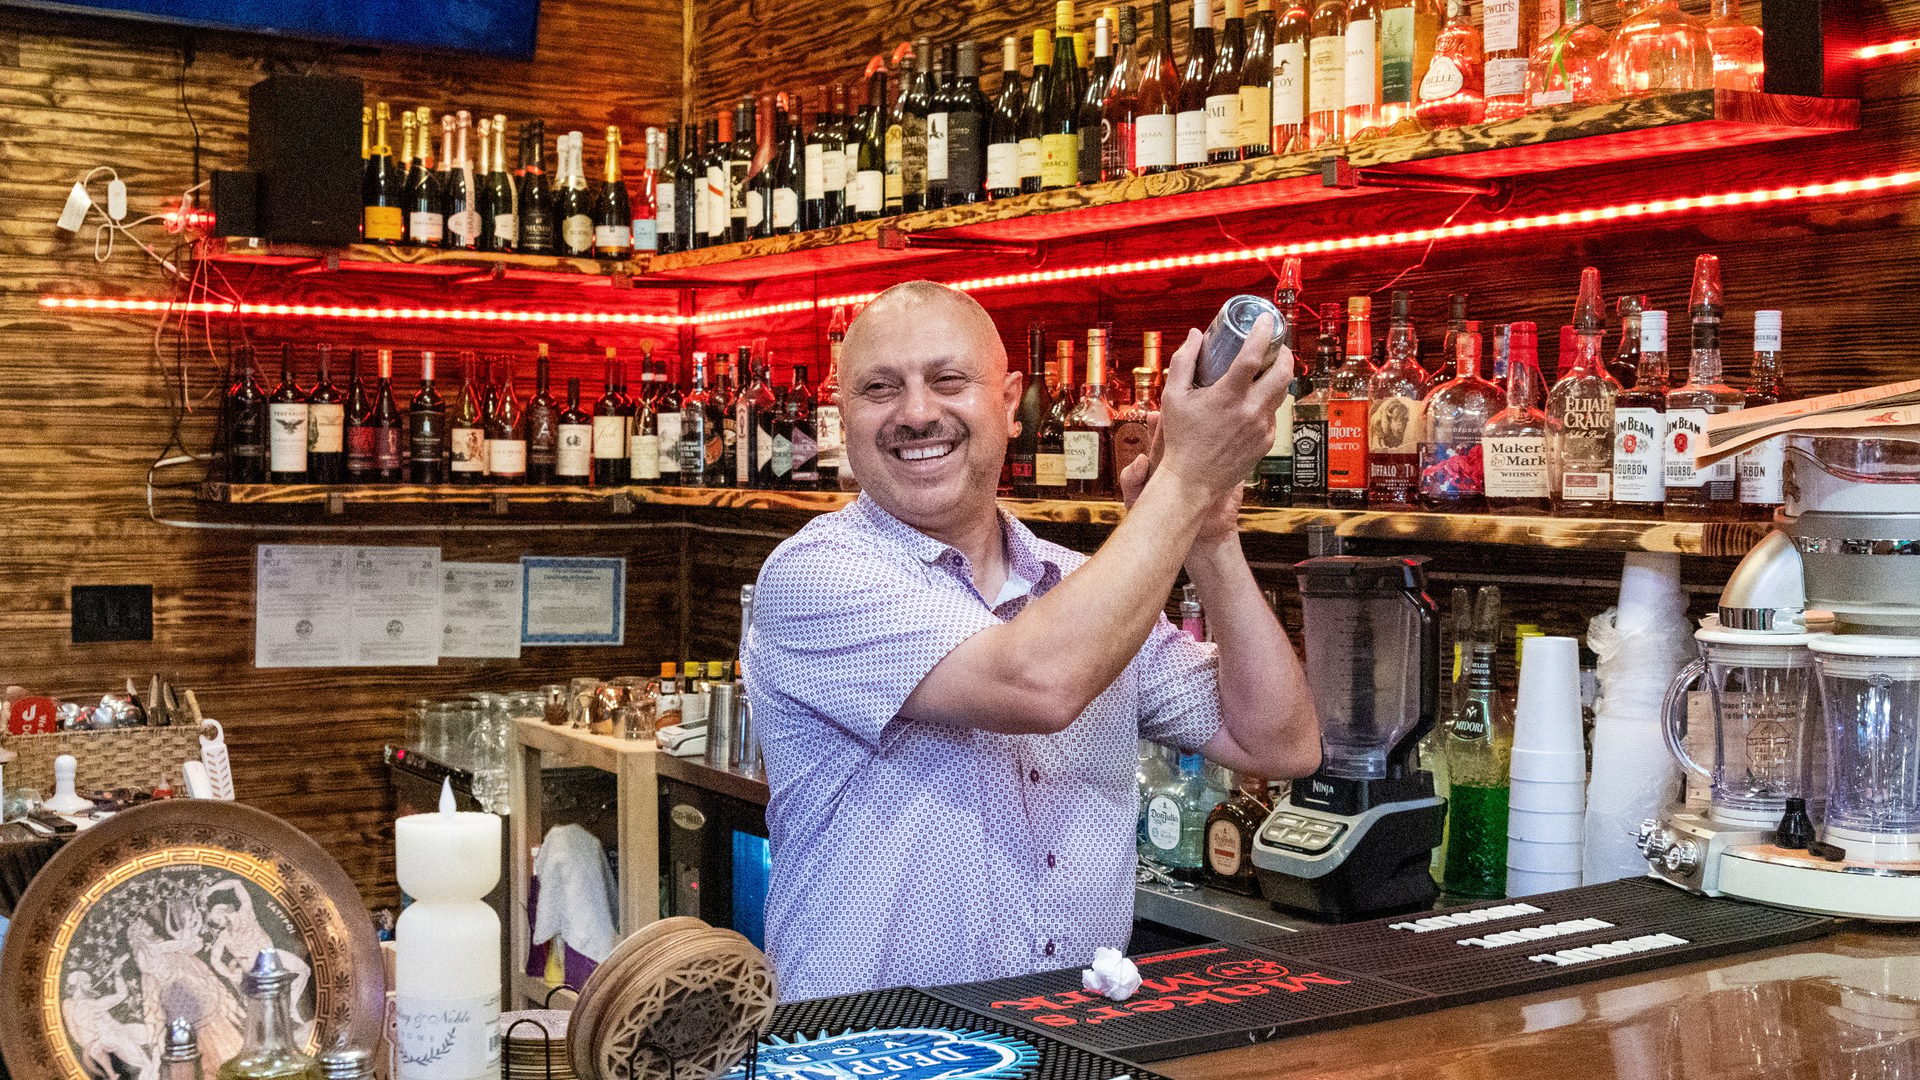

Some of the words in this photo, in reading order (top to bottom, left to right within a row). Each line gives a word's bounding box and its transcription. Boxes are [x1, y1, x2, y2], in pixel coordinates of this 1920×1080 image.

[1566, 397, 1610, 412] ELIJAH
[1564, 412, 1609, 430] CRAIG
[1628, 416, 1654, 440] BEAM
[1665, 420, 1678, 438] JIM
[1679, 416, 1701, 435] BEAM
[1329, 427, 1362, 439] more
[1507, 455, 1547, 467] Mark
[1614, 464, 1648, 475] BOURBON
[1743, 466, 1766, 477] RBON
[1455, 720, 1484, 733] MIDORI
[1312, 780, 1334, 796] NINJA
[990, 970, 1224, 1012] Mrk
[1032, 971, 1352, 1028] Maker's
[849, 1047, 972, 1075] DEEP
